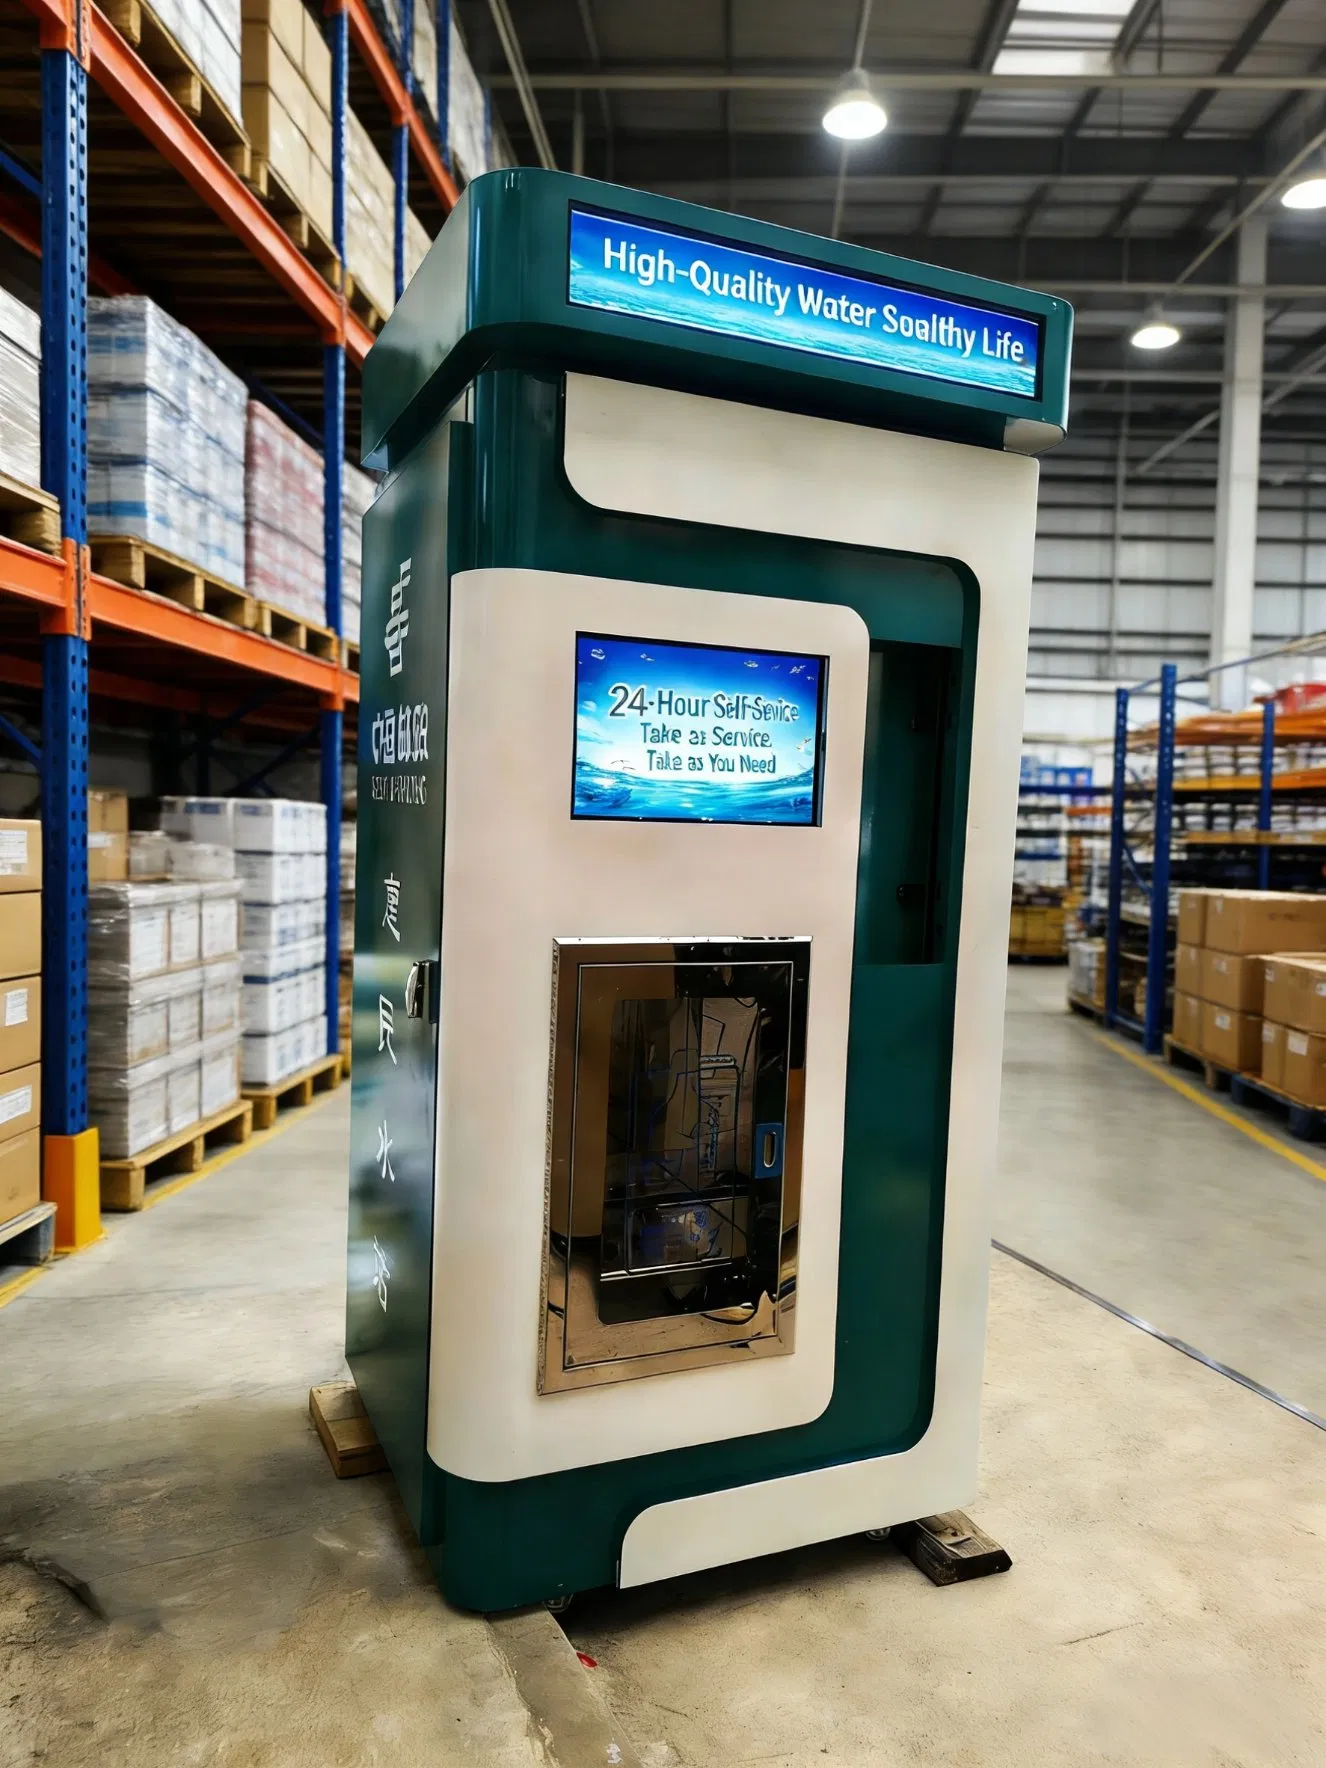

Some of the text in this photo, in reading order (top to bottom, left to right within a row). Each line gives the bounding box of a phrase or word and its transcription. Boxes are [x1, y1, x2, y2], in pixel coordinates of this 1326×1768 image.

[603, 238, 790, 316] High-Quality
[797, 283, 876, 328] Water
[982, 326, 1025, 363] Life
[640, 722, 682, 744] Take
[708, 752, 735, 773] You
[740, 754, 777, 774] Need
